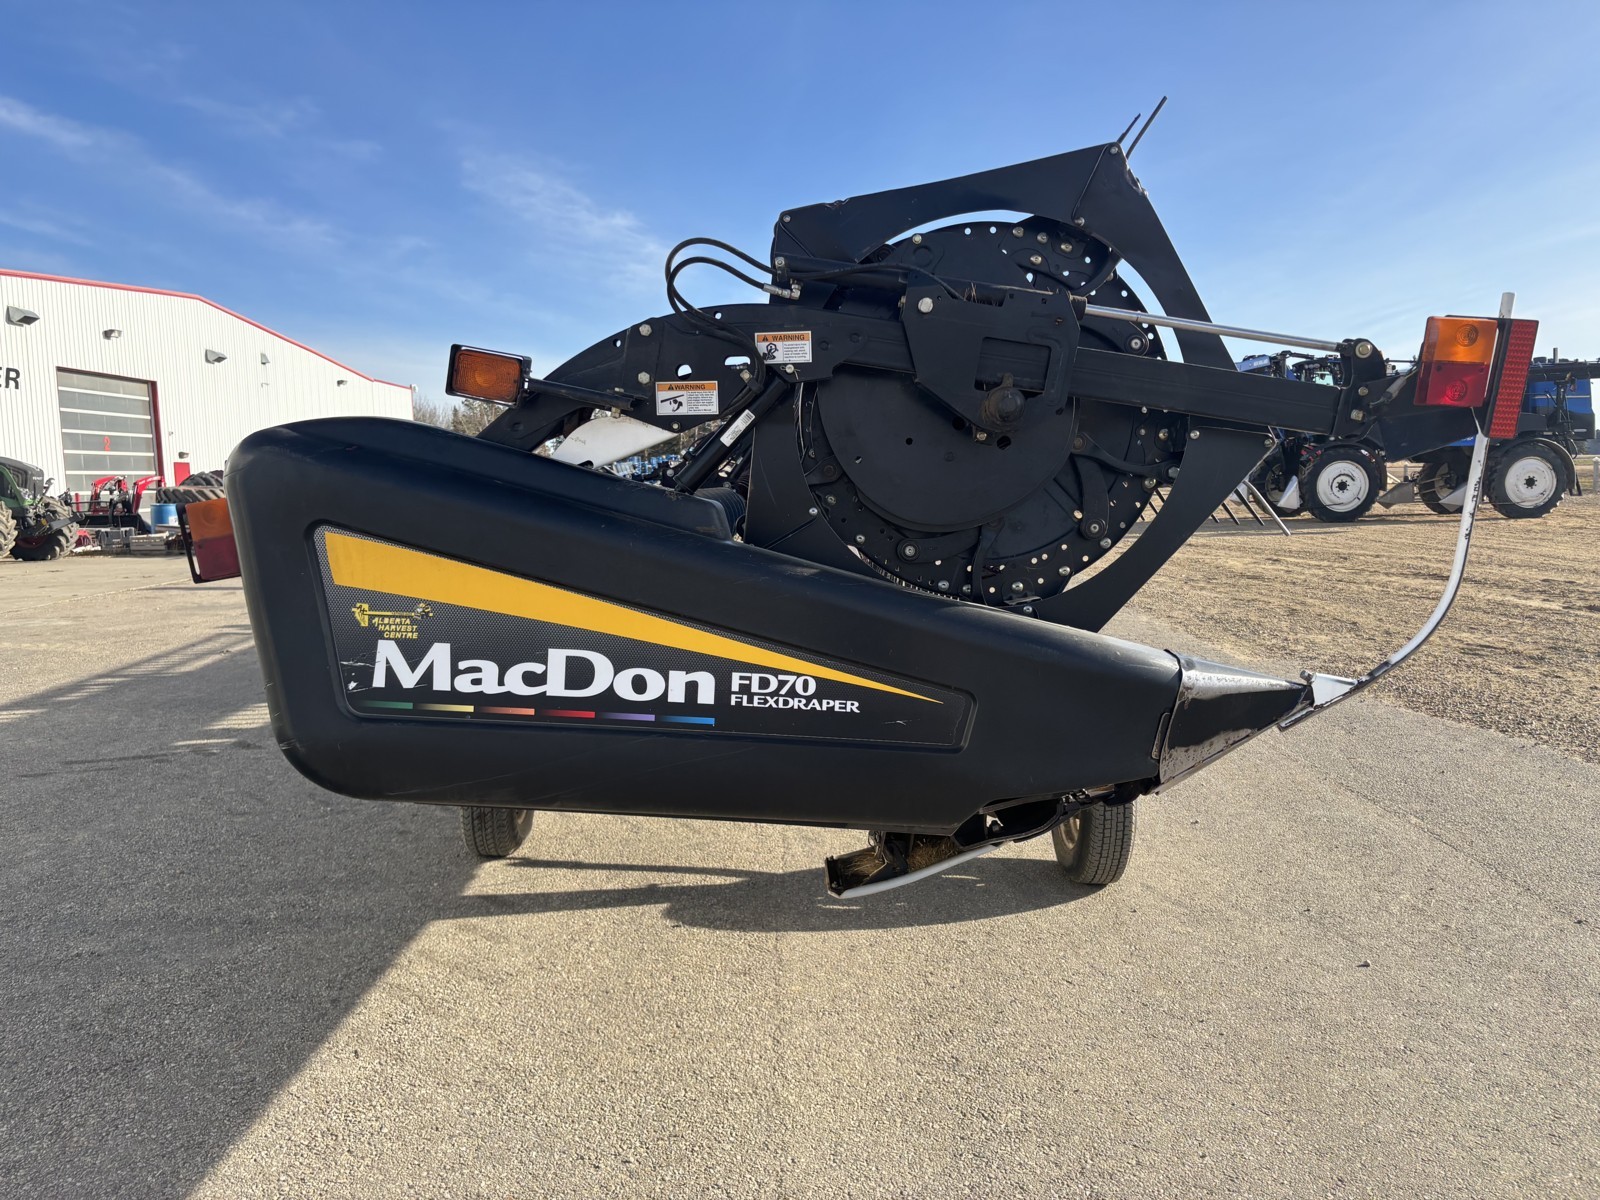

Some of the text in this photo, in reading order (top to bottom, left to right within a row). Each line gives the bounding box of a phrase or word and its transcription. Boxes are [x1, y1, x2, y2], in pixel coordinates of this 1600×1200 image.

[772, 334, 804, 342] WARNING
[0, 367, 20, 390] R
[104, 436, 111, 451] 2
[372, 617, 411, 627] ALBERTA
[378, 624, 418, 632] HARVEST
[384, 631, 418, 639] CENTRE
[372, 639, 716, 705] MacDon
[731, 672, 817, 697] FD70
[730, 694, 861, 713] FLEXDRAPER
